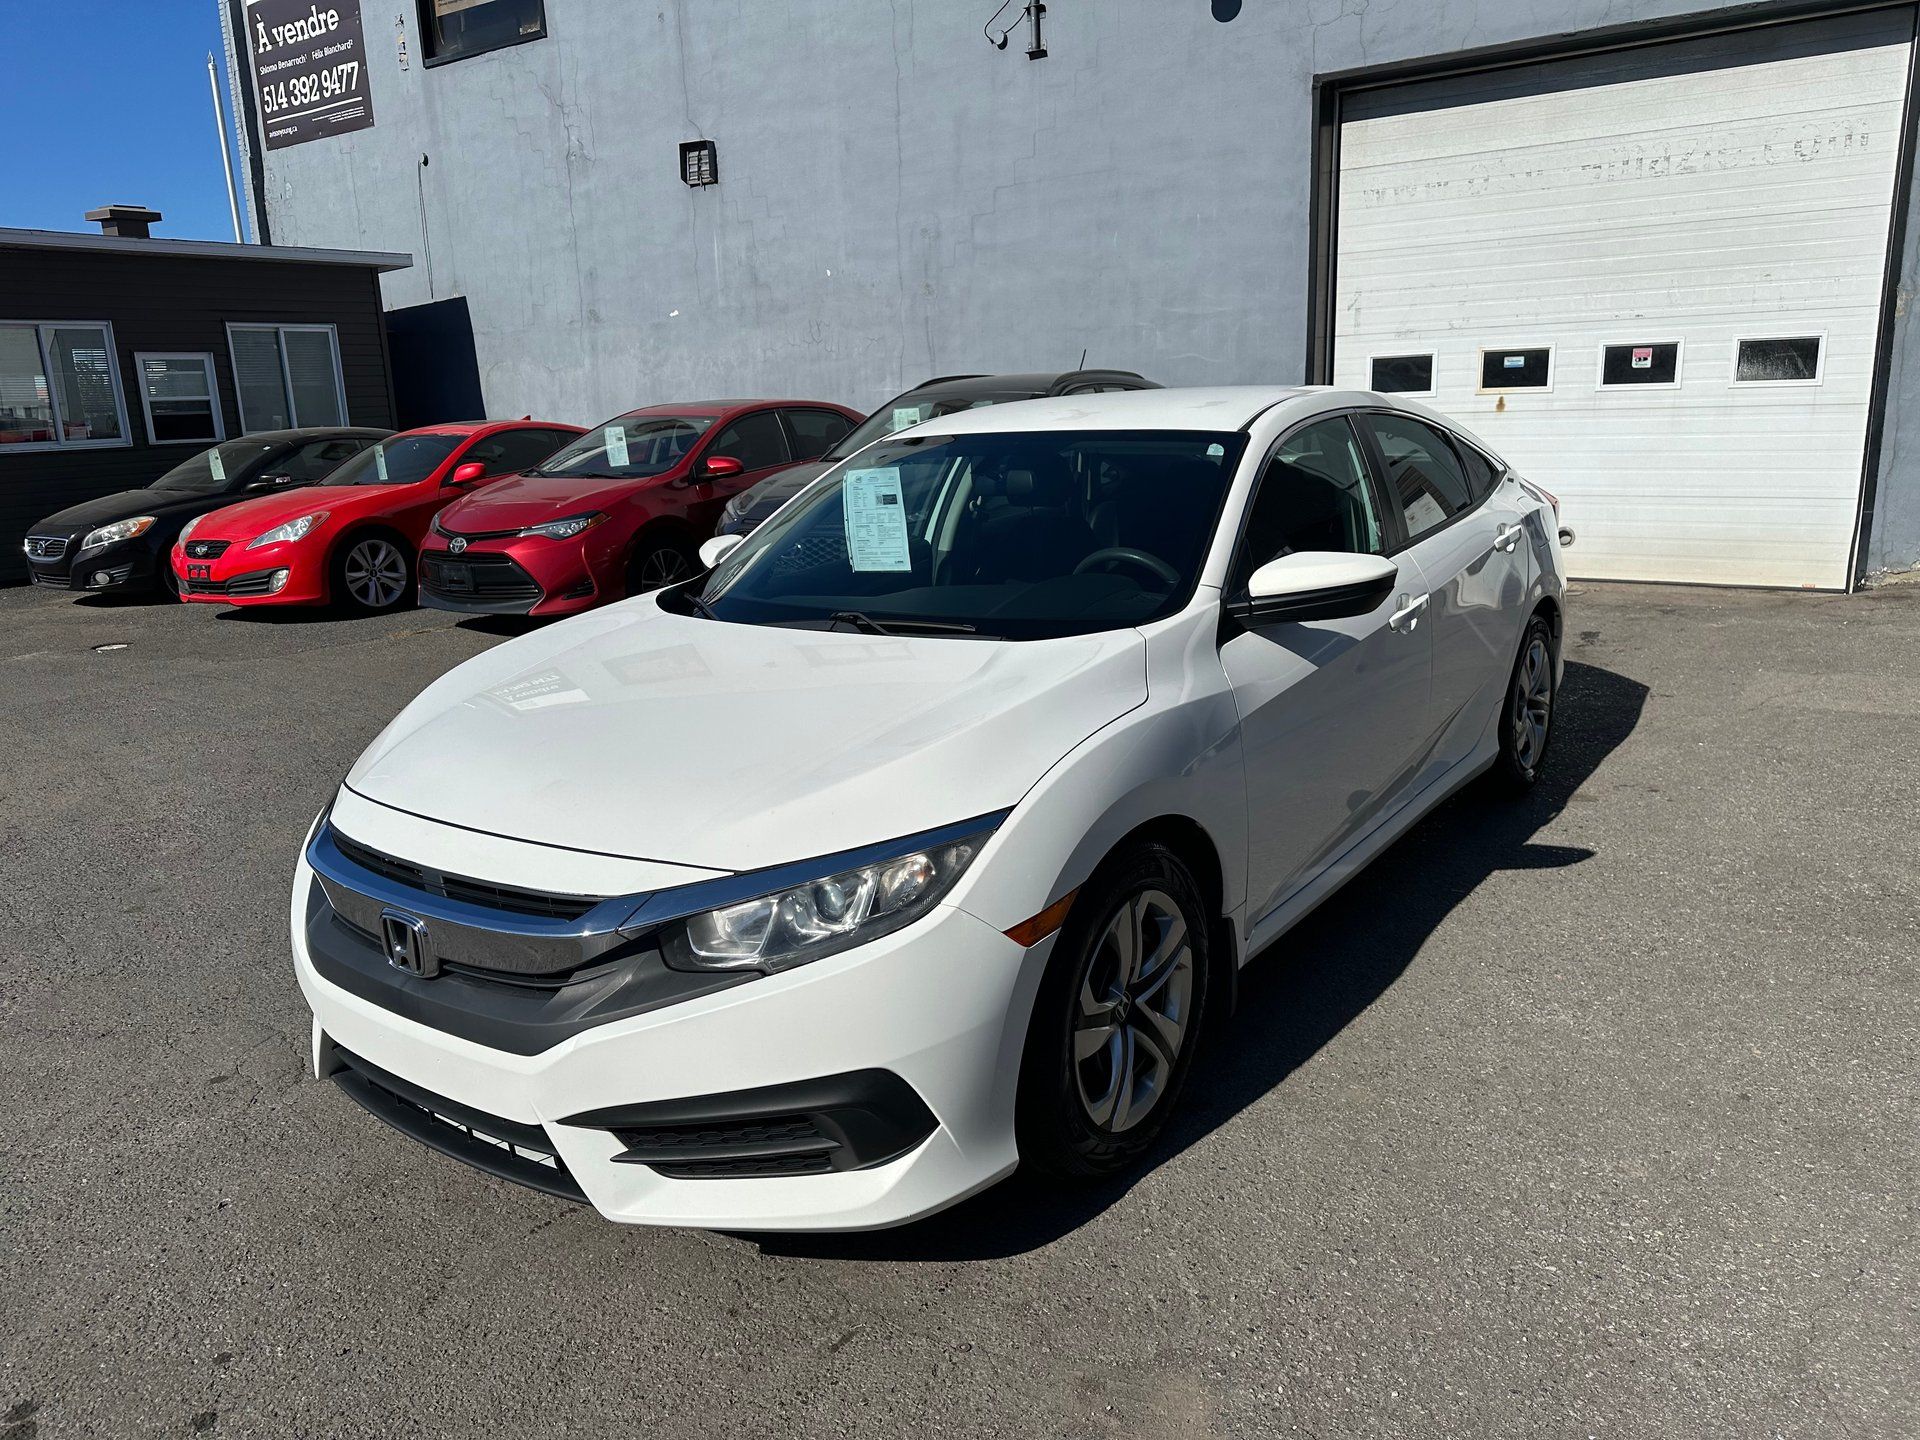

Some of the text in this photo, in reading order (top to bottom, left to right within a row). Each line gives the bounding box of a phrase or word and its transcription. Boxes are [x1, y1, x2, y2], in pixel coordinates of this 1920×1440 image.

[255, 5, 339, 54] À vendre
[262, 60, 359, 114] 514 392 9477
